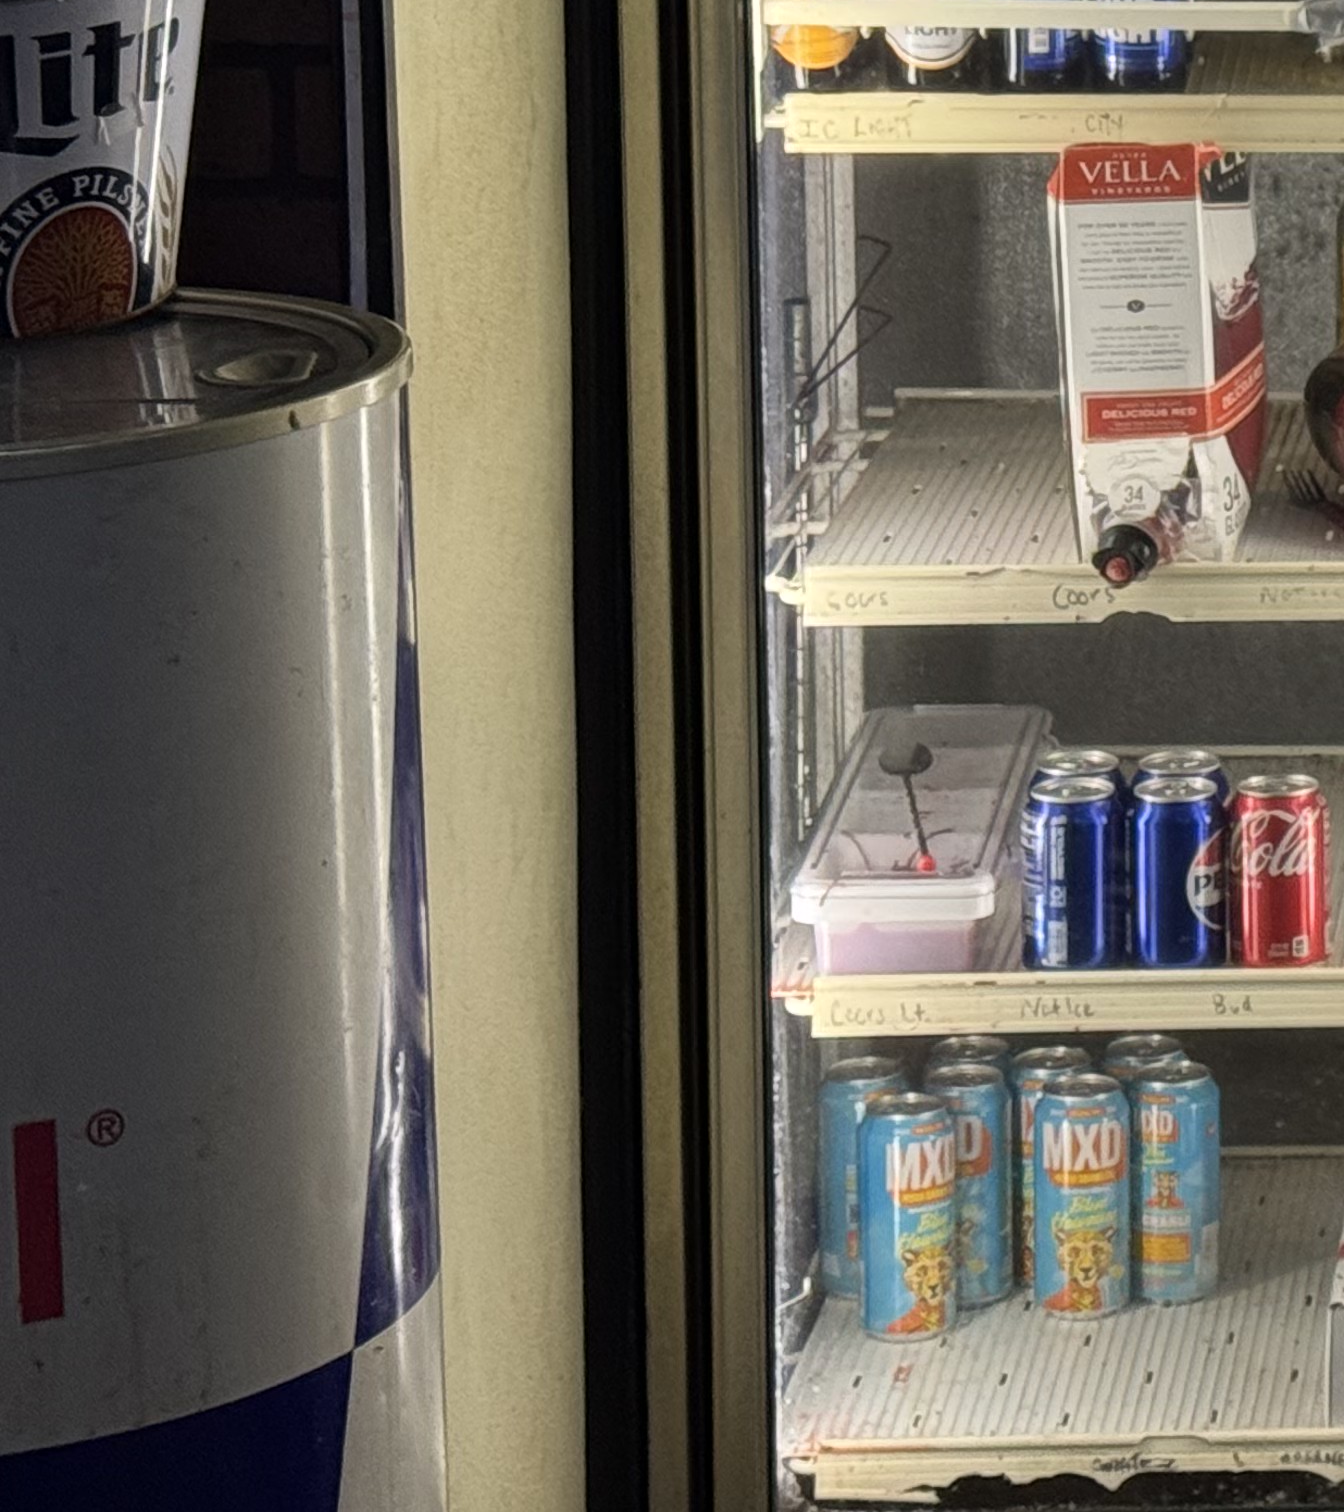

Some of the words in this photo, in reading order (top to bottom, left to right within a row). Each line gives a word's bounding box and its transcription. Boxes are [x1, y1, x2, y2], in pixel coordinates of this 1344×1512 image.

[1078, 159, 1182, 185] VELLA
[1101, 408, 1169, 420] DELICIOUS
[1171, 406, 1197, 417] RED
[1123, 485, 1144, 504] 34
[1051, 583, 1116, 611] Coors
[1212, 993, 1253, 1016] Bud
[1041, 1118, 1124, 1174] MXD
